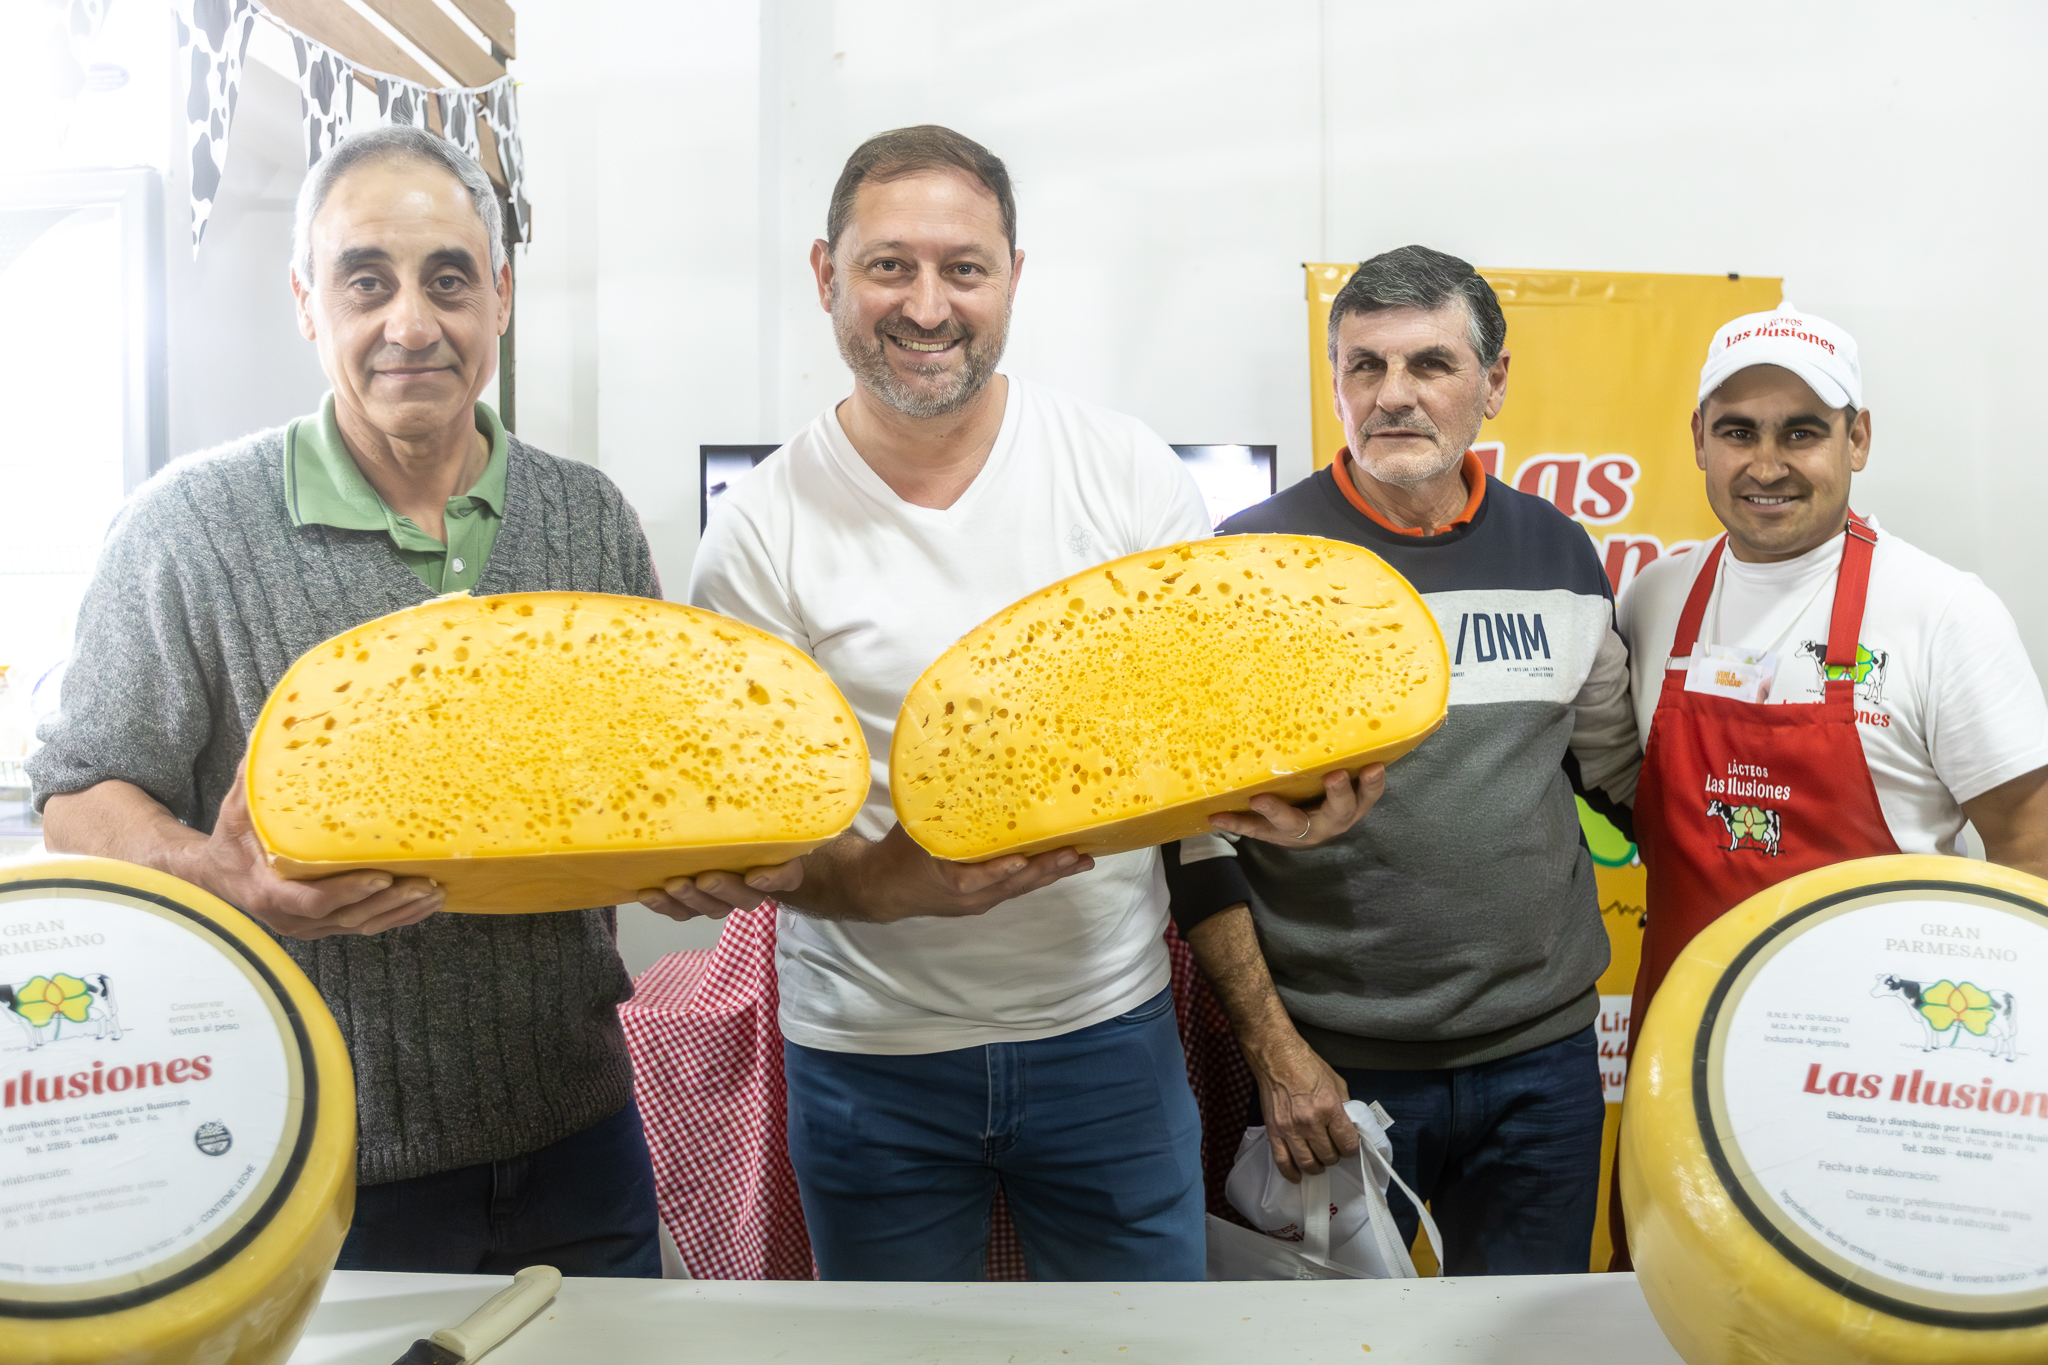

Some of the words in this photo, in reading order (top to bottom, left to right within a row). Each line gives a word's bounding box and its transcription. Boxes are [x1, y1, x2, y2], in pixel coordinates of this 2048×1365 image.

[1726, 330, 1751, 349] Las
[1755, 327, 1836, 356] Ilusiones
[1704, 773, 1725, 794] Las
[1727, 776, 1791, 801] Ilusiones
[3, 918, 66, 938] GRAN
[1920, 922, 1981, 940] GRAN
[1885, 937, 2018, 963] PARMESANO
[170, 999, 225, 1012] Conservar
[170, 1024, 200, 1036] Venta
[203, 1022, 213, 1033] al
[214, 1022, 240, 1034] peso
[1763, 1034, 1804, 1045] Industria
[1806, 1037, 1851, 1049] Argentina
[3, 1054, 213, 1109] Ilusiones
[1802, 1063, 1883, 1100] Las
[147, 1098, 191, 1112] Ilusiones
[1826, 1110, 1877, 1124] Elaborado
[1856, 1125, 1881, 1136] Zona
[1818, 1160, 1853, 1173] Fecha
[1854, 1163, 1870, 1175] de
[1845, 1189, 1901, 1207] Consumir
[1865, 1206, 1882, 1218] de
